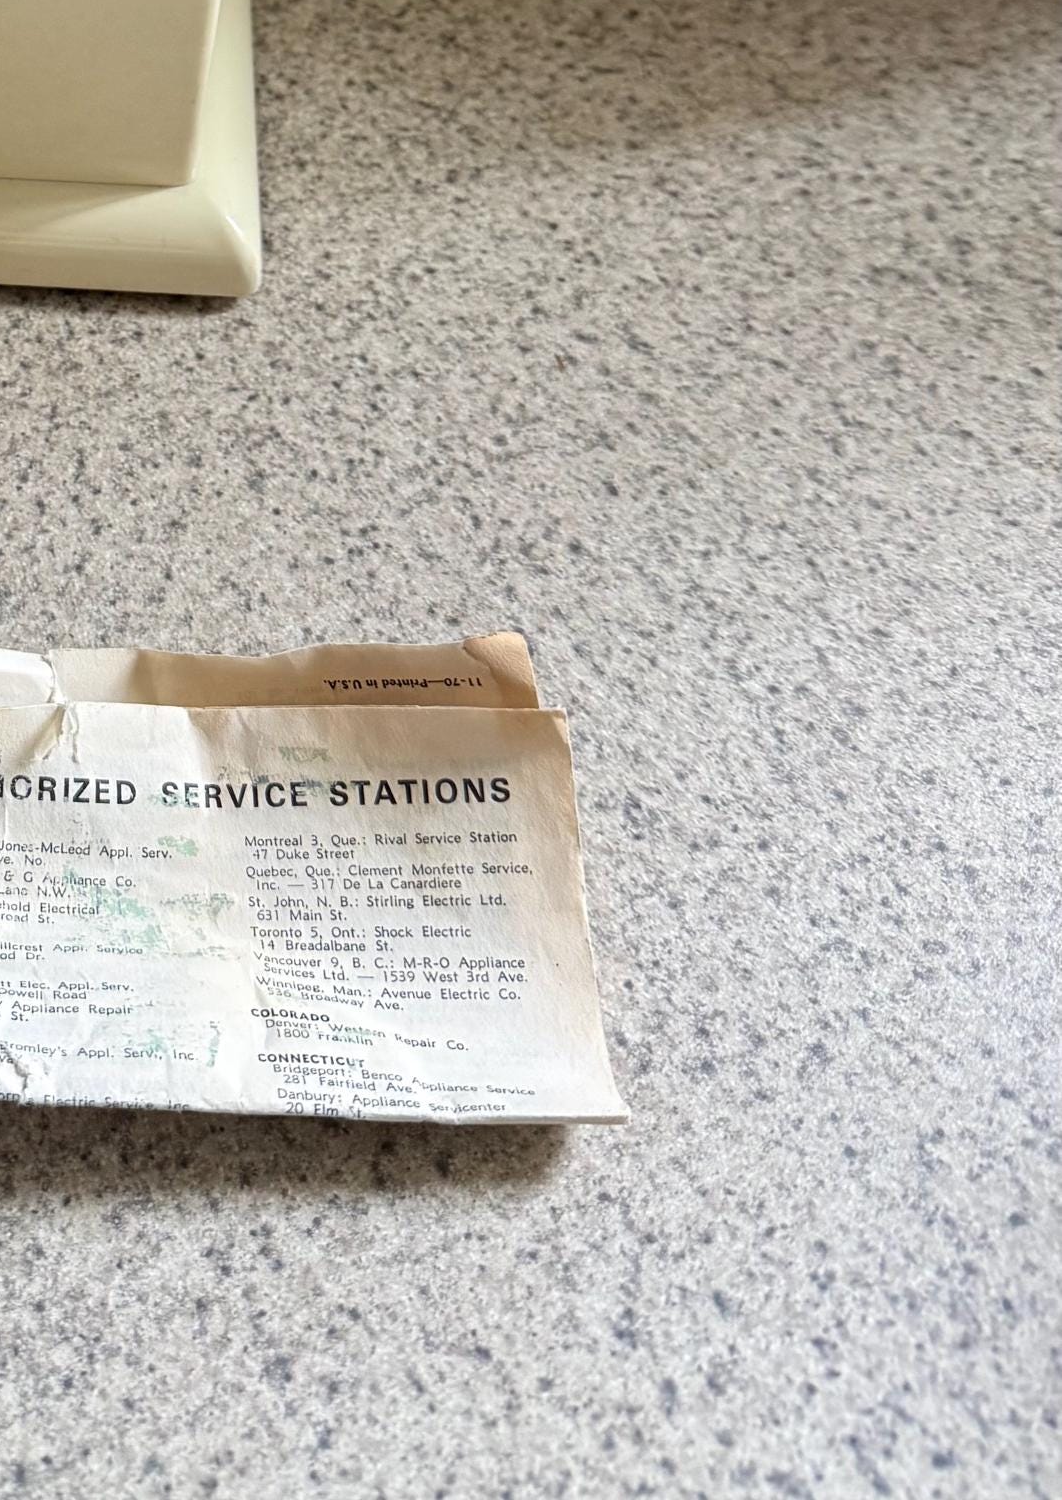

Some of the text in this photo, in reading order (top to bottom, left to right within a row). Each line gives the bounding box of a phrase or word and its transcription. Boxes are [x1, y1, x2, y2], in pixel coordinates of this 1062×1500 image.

[323, 678, 363, 690] U.S.A.
[367, 678, 378, 689] in
[161, 778, 308, 809] SERVICE
[329, 777, 511, 806] STATIONS
[244, 835, 303, 847] Montreal
[331, 834, 366, 848] Que.:
[374, 833, 407, 845] Rival
[415, 833, 461, 845] Service
[469, 831, 518, 843] Station
[99, 846, 133, 859] Appl.
[141, 847, 172, 859] Serv.
[252, 848, 355, 860] 47 Duke Street
[24, 854, 46, 867] No.
[245, 862, 533, 879] Quebec, Que.: Clement Monfette Service,
[3, 870, 14, 882] &
[23, 871, 34, 883] G
[115, 875, 137, 887] Co.
[256, 878, 462, 890] Inc. 317 De La Canardiere
[37, 886, 71, 898] N.W.
[40, 902, 100, 915] Electrical
[248, 896, 266, 908] St.
[273, 896, 308, 910] John,
[317, 896, 332, 908] N.
[366, 895, 415, 909] Stirling
[422, 895, 472, 907] Electric
[480, 894, 506, 907] Ltd.
[38, 913, 55, 925] St.
[256, 909, 347, 921] 631 Main St.
[250, 926, 303, 938] Toronto
[331, 926, 366, 938] Ont.:
[374, 925, 414, 938] Shock
[422, 925, 472, 938] Electric
[260, 940, 393, 952] 14 Breadalbane St.
[25, 952, 45, 960] Dr.
[253, 951, 322, 968] Vancouver
[352, 957, 365, 968] B.
[403, 957, 450, 969] M-R-O
[458, 957, 525, 971] Appliance
[264, 963, 528, 983] Services Ltd. 1539 West 3rd Ave.
[20, 980, 51, 990] Elec.
[57, 981, 93, 994] Appl.
[101, 982, 135, 992] Serv.
[53, 988, 87, 1000] Road
[333, 985, 372, 998] Man.:
[380, 987, 432, 1000] Avenue
[440, 988, 490, 1000] Electric
[499, 989, 521, 1000] Co.
[301, 991, 365, 1008] Broadway
[374, 1000, 404, 1011] Ave.
[11, 1001, 80, 1015] Appliance
[88, 1004, 133, 1016] Repair
[251, 1008, 330, 1022] COLORADO
[11, 1011, 29, 1021] St.
[265, 1019, 319, 1030] Denver:
[446, 1040, 469, 1050] Co.
[277, 1028, 310, 1039] 1800
[77, 1047, 114, 1060] Appl.
[173, 1050, 198, 1061] Inc.
[258, 1053, 365, 1068] CONNECTICUT
[273, 1064, 535, 1096] Bridgeport: Benco Appliance Service
[283, 1074, 416, 1094] 281 Fairfield Ave.
[277, 1088, 342, 1104] Danbury:
[352, 1094, 420, 1109] Appliance
[285, 1102, 304, 1115] 20
[314, 1102, 338, 1116] Elm
